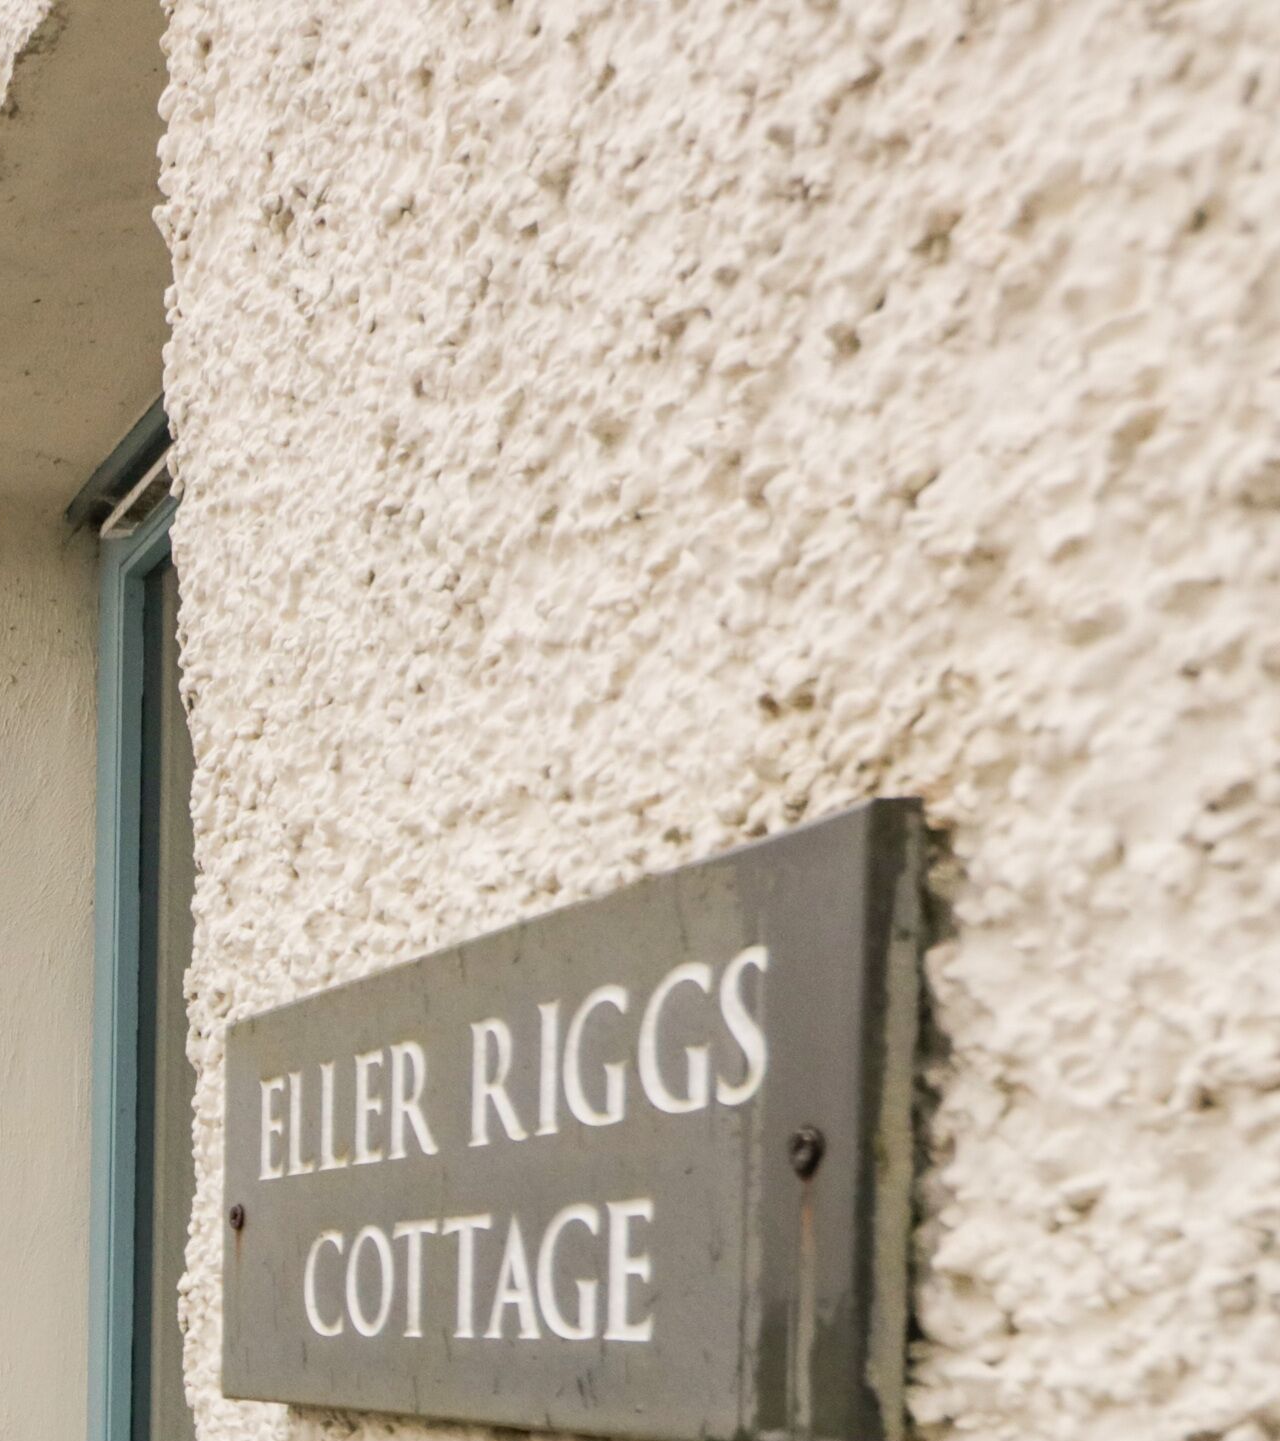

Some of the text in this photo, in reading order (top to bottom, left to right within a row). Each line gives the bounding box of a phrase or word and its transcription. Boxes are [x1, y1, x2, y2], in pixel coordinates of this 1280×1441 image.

[259, 945, 769, 1181] ELLER RIGGS
[303, 1198, 654, 1342] COTTAGE
